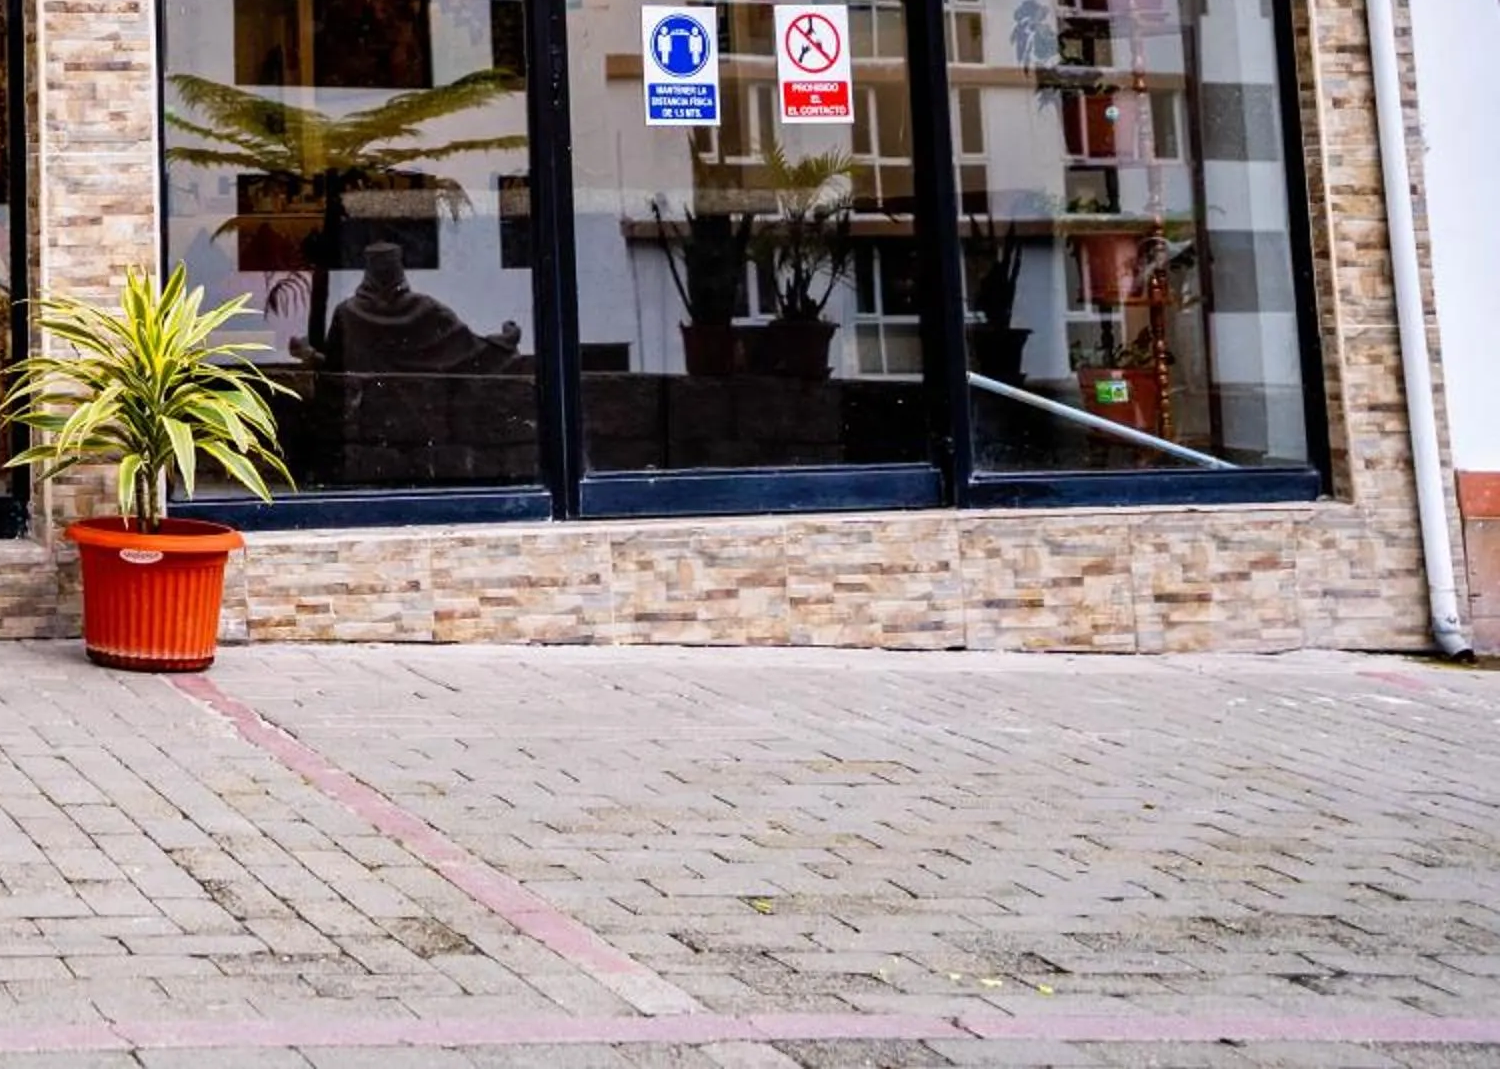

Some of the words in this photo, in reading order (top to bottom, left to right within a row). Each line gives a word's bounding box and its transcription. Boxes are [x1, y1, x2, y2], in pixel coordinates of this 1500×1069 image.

[698, 87, 707, 96] LA
[791, 83, 840, 92] PROHIBIDO
[801, 106, 847, 115] CONTACTO
